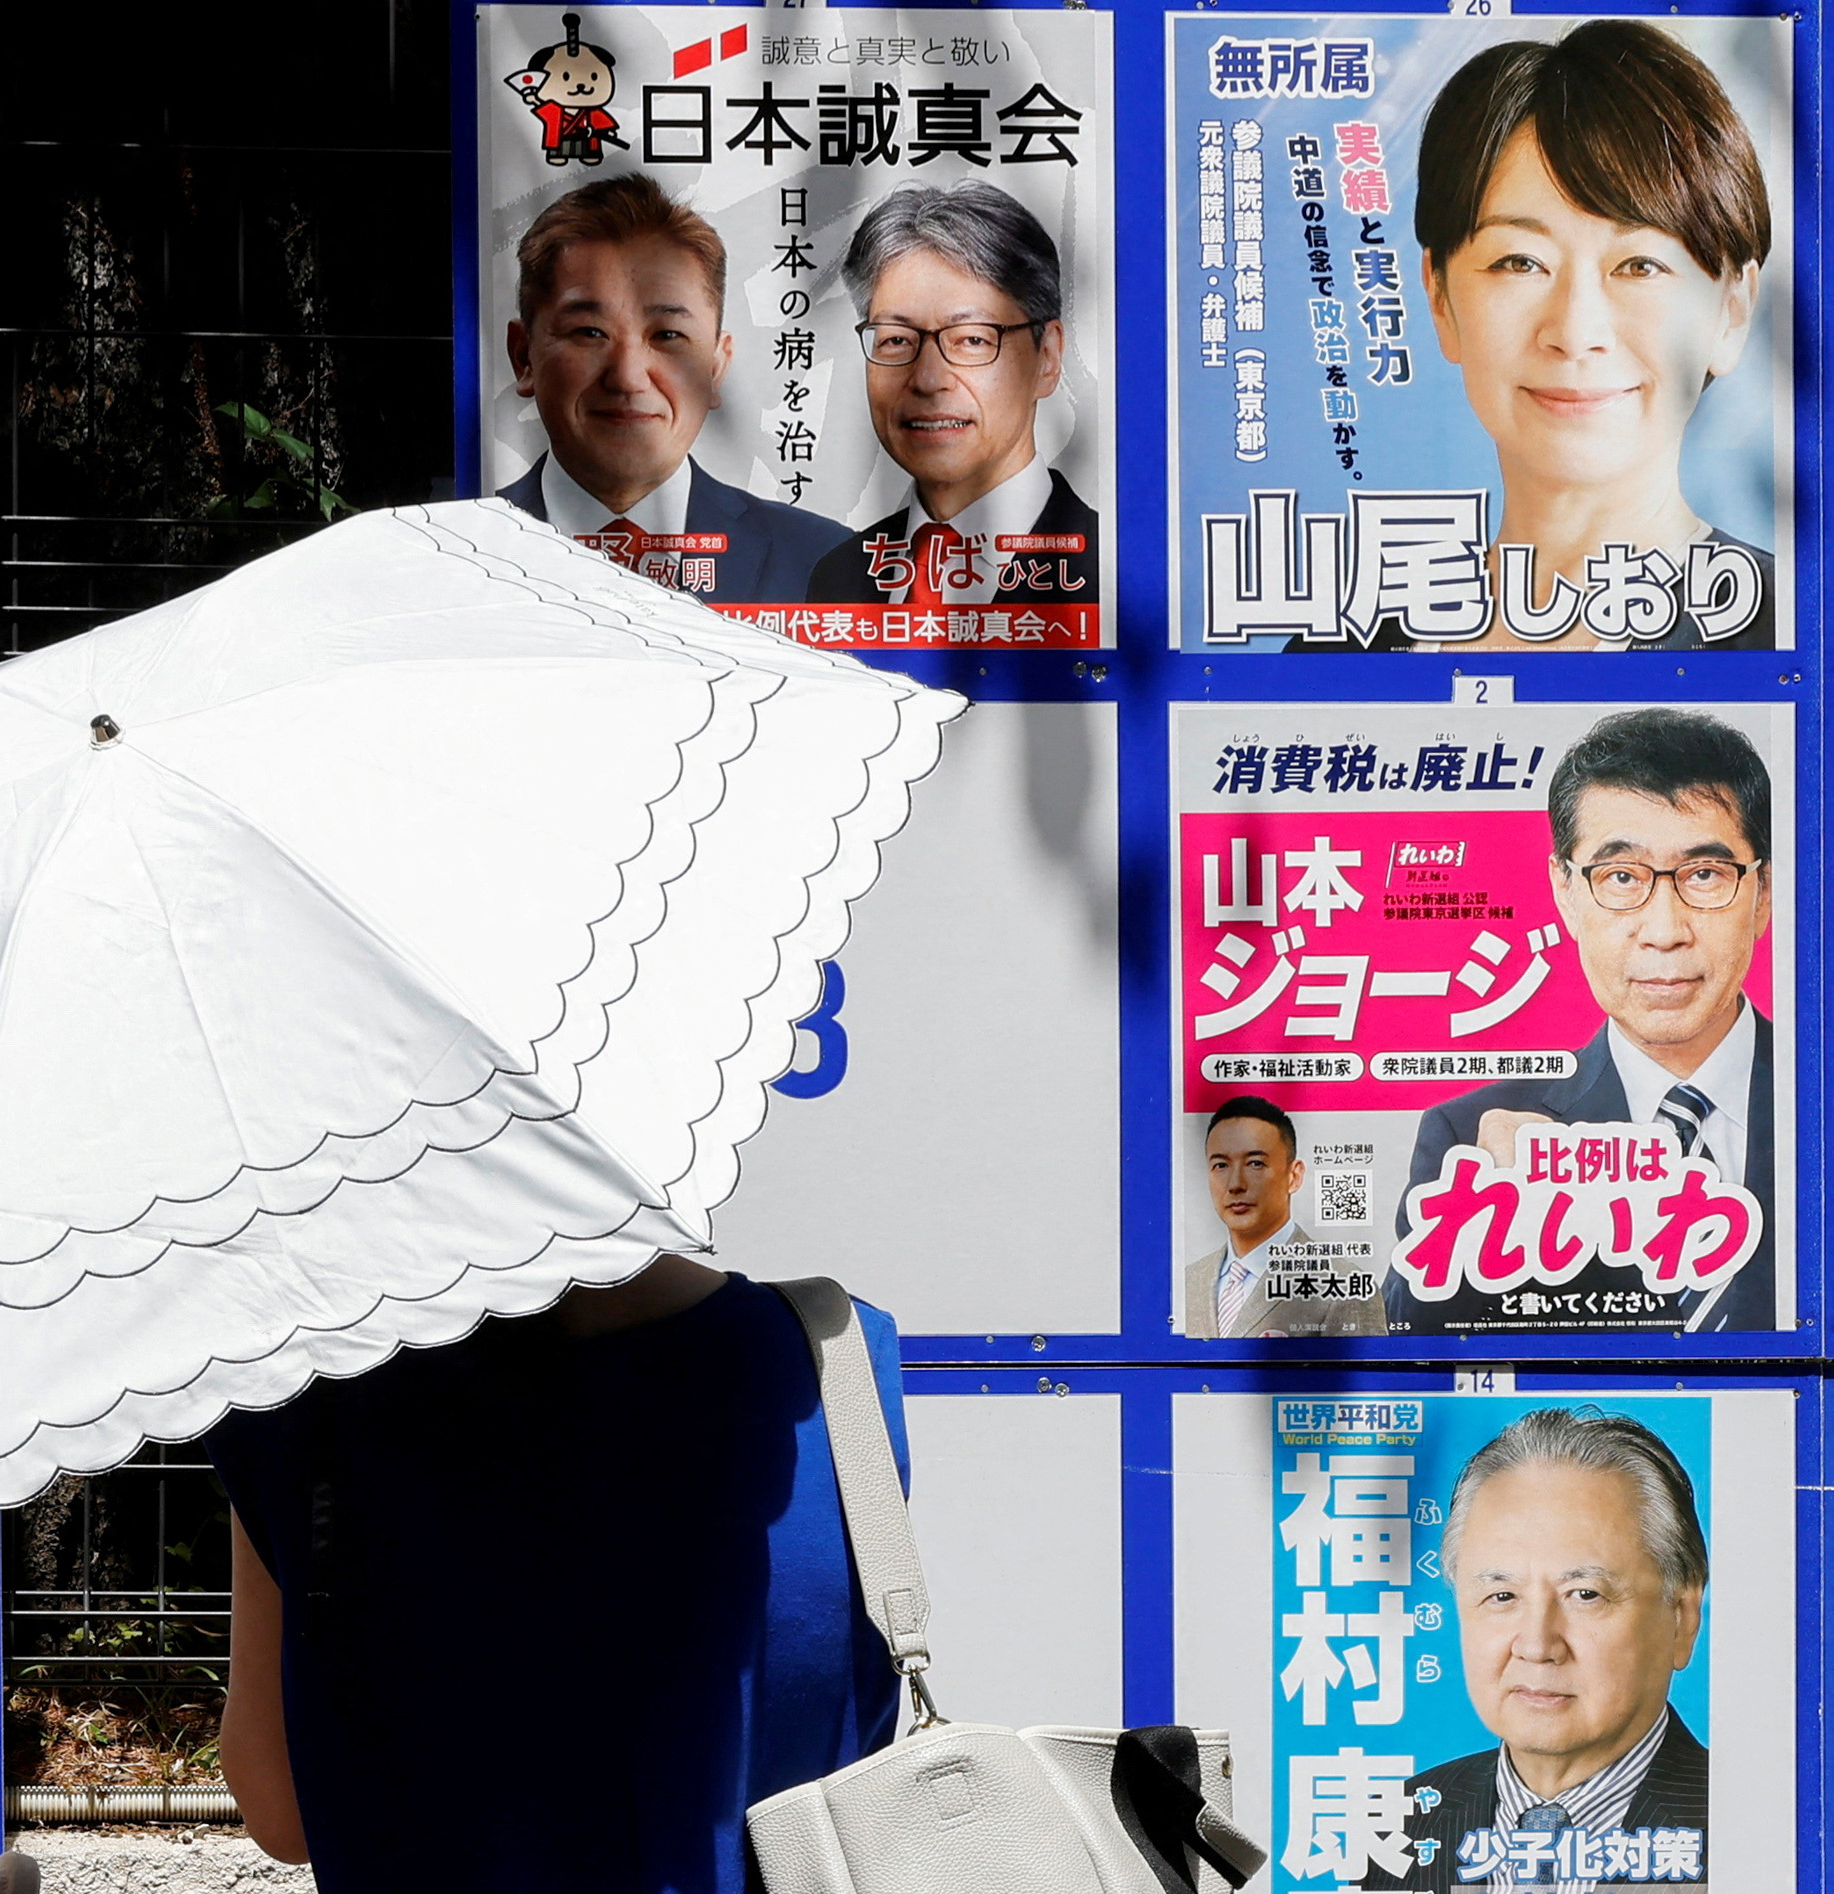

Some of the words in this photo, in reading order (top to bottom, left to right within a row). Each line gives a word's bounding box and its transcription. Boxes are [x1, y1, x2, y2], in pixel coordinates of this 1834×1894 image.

[1466, 0, 1491, 15] 26
[762, 36, 1010, 67] 誠意と真実と敬い
[1212, 39, 1373, 96] 無所属
[641, 82, 1083, 168] 日本誠真会
[1232, 119, 1265, 331] 参議院議員候補
[1198, 119, 1226, 369] 元衆議院議員・弁護士
[1334, 120, 1411, 385] 実績と実行力
[1286, 133, 1363, 481] 中道の信念で政治を動かす。
[771, 186, 817, 506] 日本の病を治す
[1234, 348, 1267, 464] （東京都）
[641, 537, 697, 549] 日本誠真会
[699, 536, 723, 549] 党首
[1000, 536, 1079, 549] 参議院議員候補
[1201, 488, 1764, 644] 山尾しおり
[1475, 681, 1487, 704] 2
[1212, 743, 1544, 794] 消費税は廃止！
[1202, 836, 1364, 929] 山本
[1383, 892, 1459, 905] れいわ新選組
[1463, 892, 1488, 905] 公認
[1383, 907, 1485, 920] 参議院東京選挙区
[1488, 907, 1514, 919] 候補
[1193, 922, 1561, 1041] ジョージ
[1213, 1058, 1352, 1080] 作家・福祉活動家
[1382, 1056, 1564, 1077] 衆院議員2期、都議2期
[1313, 1144, 1374, 1154] れいわ新選組
[1313, 1155, 1374, 1165] ホームページ
[1527, 1136, 1667, 1184] 比例は
[1404, 1157, 1750, 1288] れいわ
[1268, 1244, 1343, 1256] れいわ新選組
[1347, 1243, 1371, 1255] 代表
[1268, 1259, 1330, 1272] 参議院議員
[1267, 1273, 1374, 1299] 山本太郎
[1500, 1291, 1666, 1315] と書いてください
[1389, 1322, 1411, 1331] ところ
[1471, 1370, 1495, 1393] 14
[1282, 1403, 1420, 1432] 世界平和党
[1282, 1434, 1323, 1446] World
[1327, 1434, 1372, 1446] Peace
[1376, 1434, 1416, 1448] Party
[1455, 1827, 1704, 1883] 少子化対策
